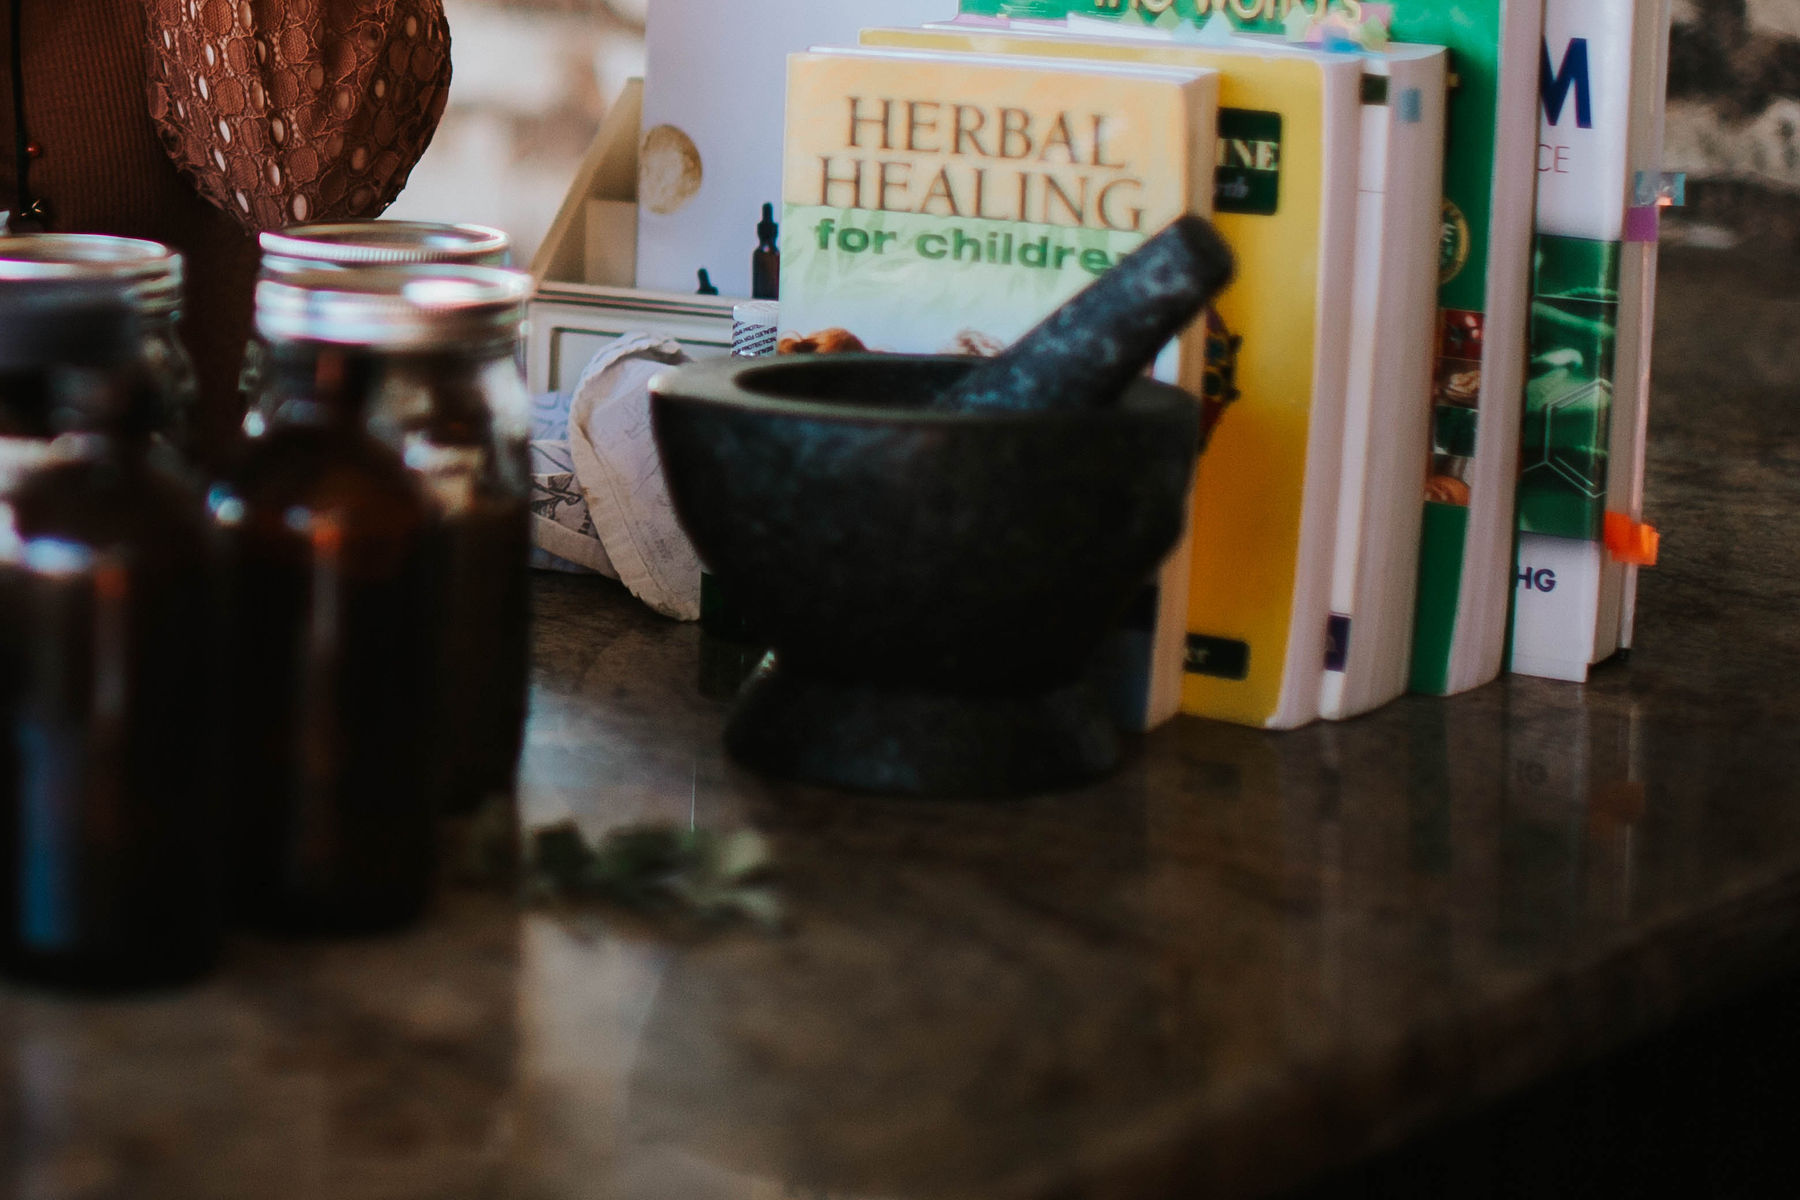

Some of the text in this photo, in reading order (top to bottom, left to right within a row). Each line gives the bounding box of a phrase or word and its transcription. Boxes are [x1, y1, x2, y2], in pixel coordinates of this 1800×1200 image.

[845, 95, 1127, 170] HERBAL
[817, 155, 1143, 232] HEALING
[814, 218, 898, 255] for
